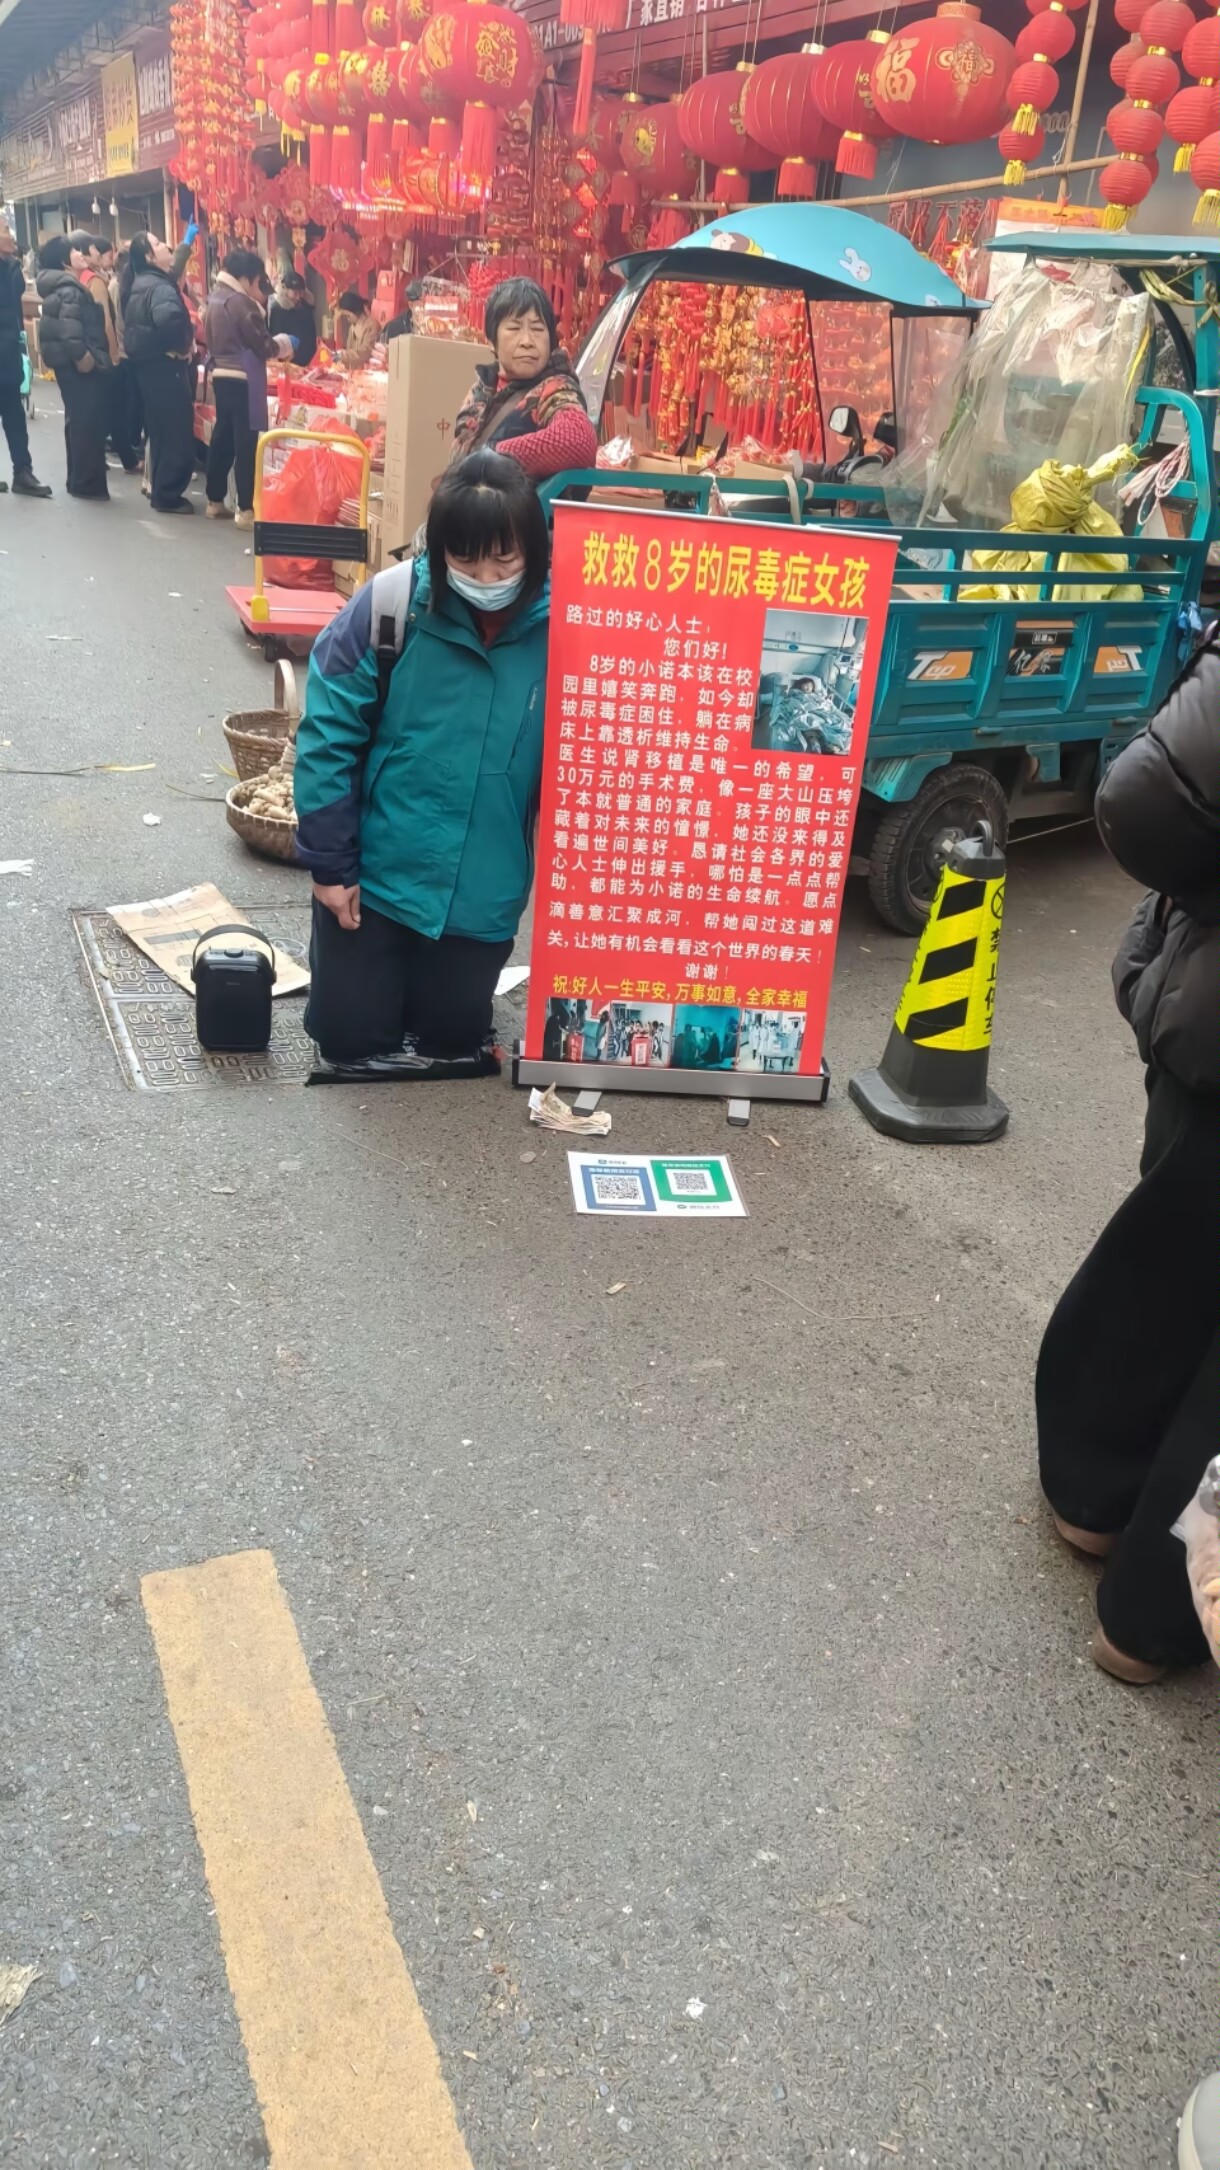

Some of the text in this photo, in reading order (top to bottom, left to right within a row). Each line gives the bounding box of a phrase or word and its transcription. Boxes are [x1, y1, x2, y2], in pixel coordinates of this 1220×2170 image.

[582, 530, 870, 609] 救救8岁的尿毒症女孩
[589, 655, 753, 687] 8岁的小诺本该在校
